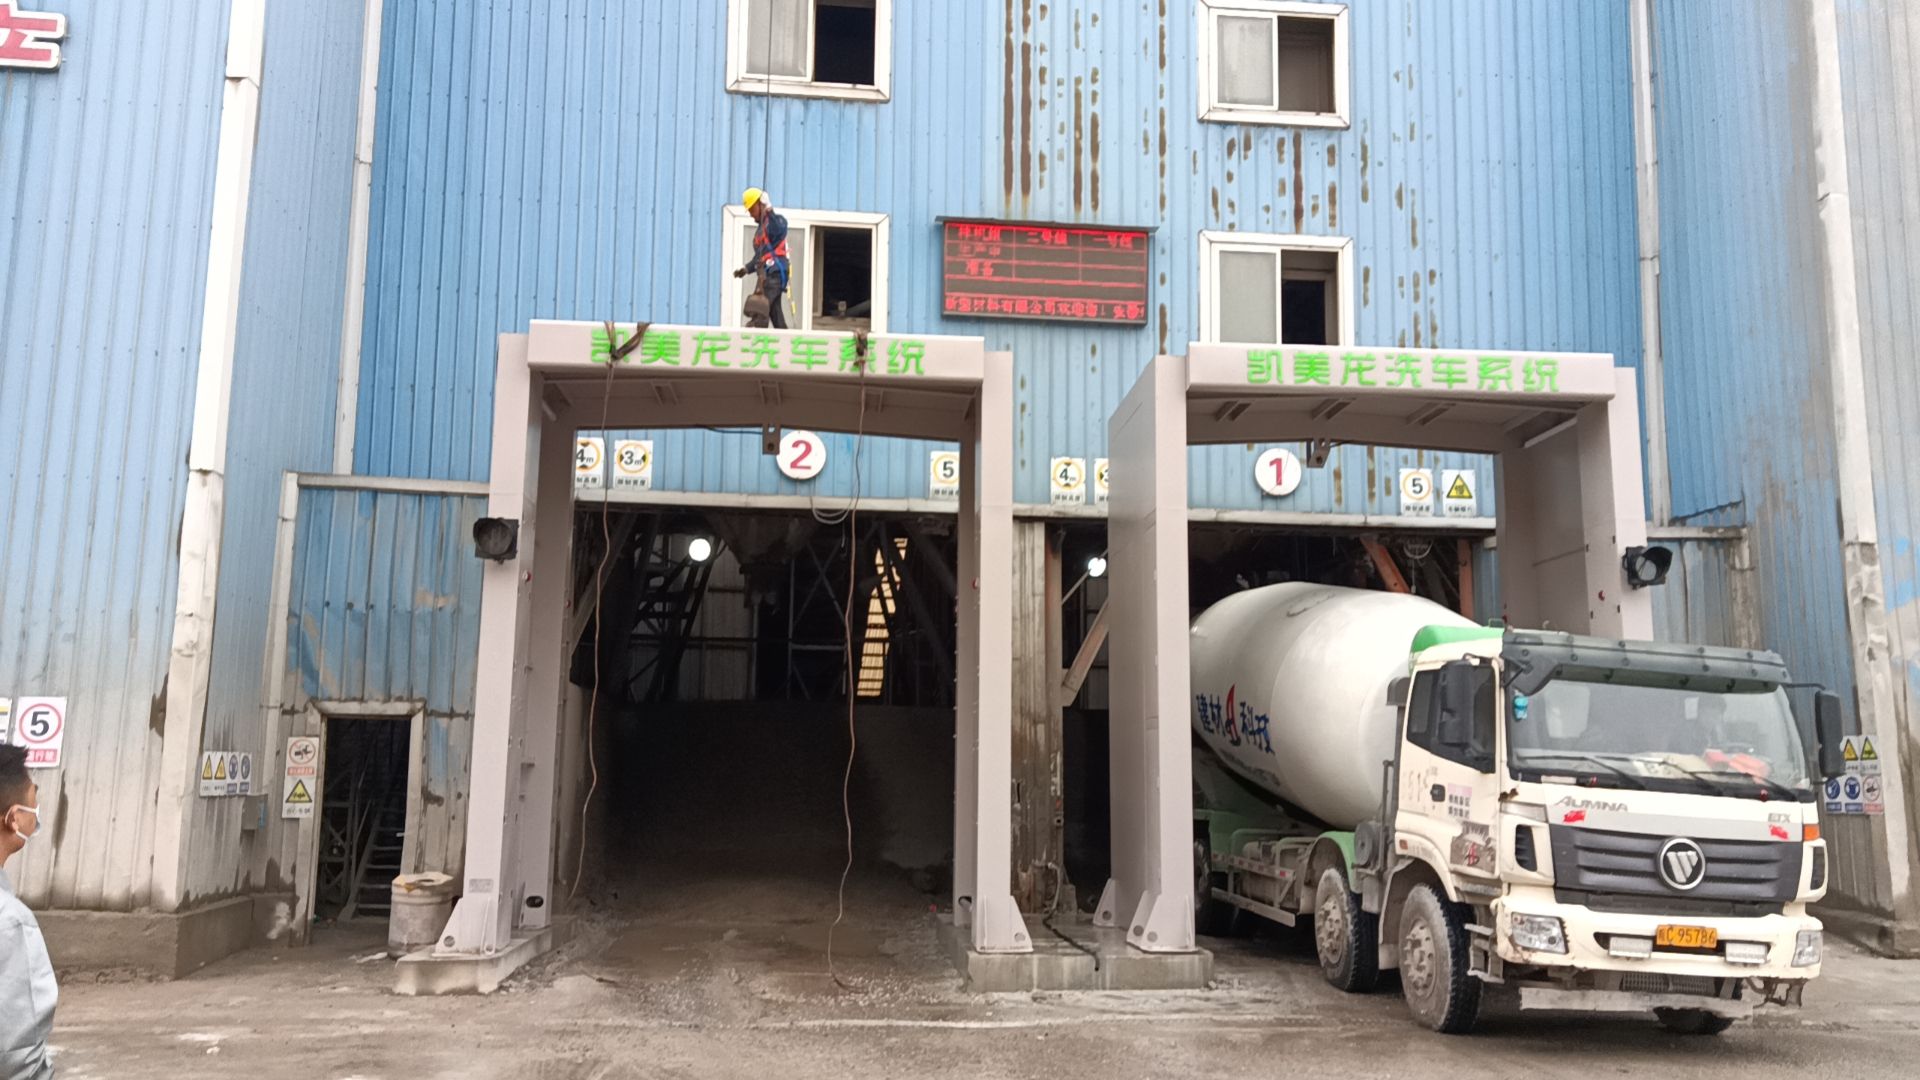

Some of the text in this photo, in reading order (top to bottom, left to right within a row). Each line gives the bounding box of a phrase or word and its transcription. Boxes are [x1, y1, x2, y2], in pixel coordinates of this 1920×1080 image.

[591, 327, 926, 376] 凯美龙洗车系统
[1246, 349, 1560, 393] 凯美龙洗车系统
[624, 451, 642, 466] 3m
[789, 439, 813, 471] 2
[942, 460, 954, 479] 5
[1268, 456, 1283, 487] 1
[1411, 477, 1424, 495] 5
[30, 710, 50, 737] 5
